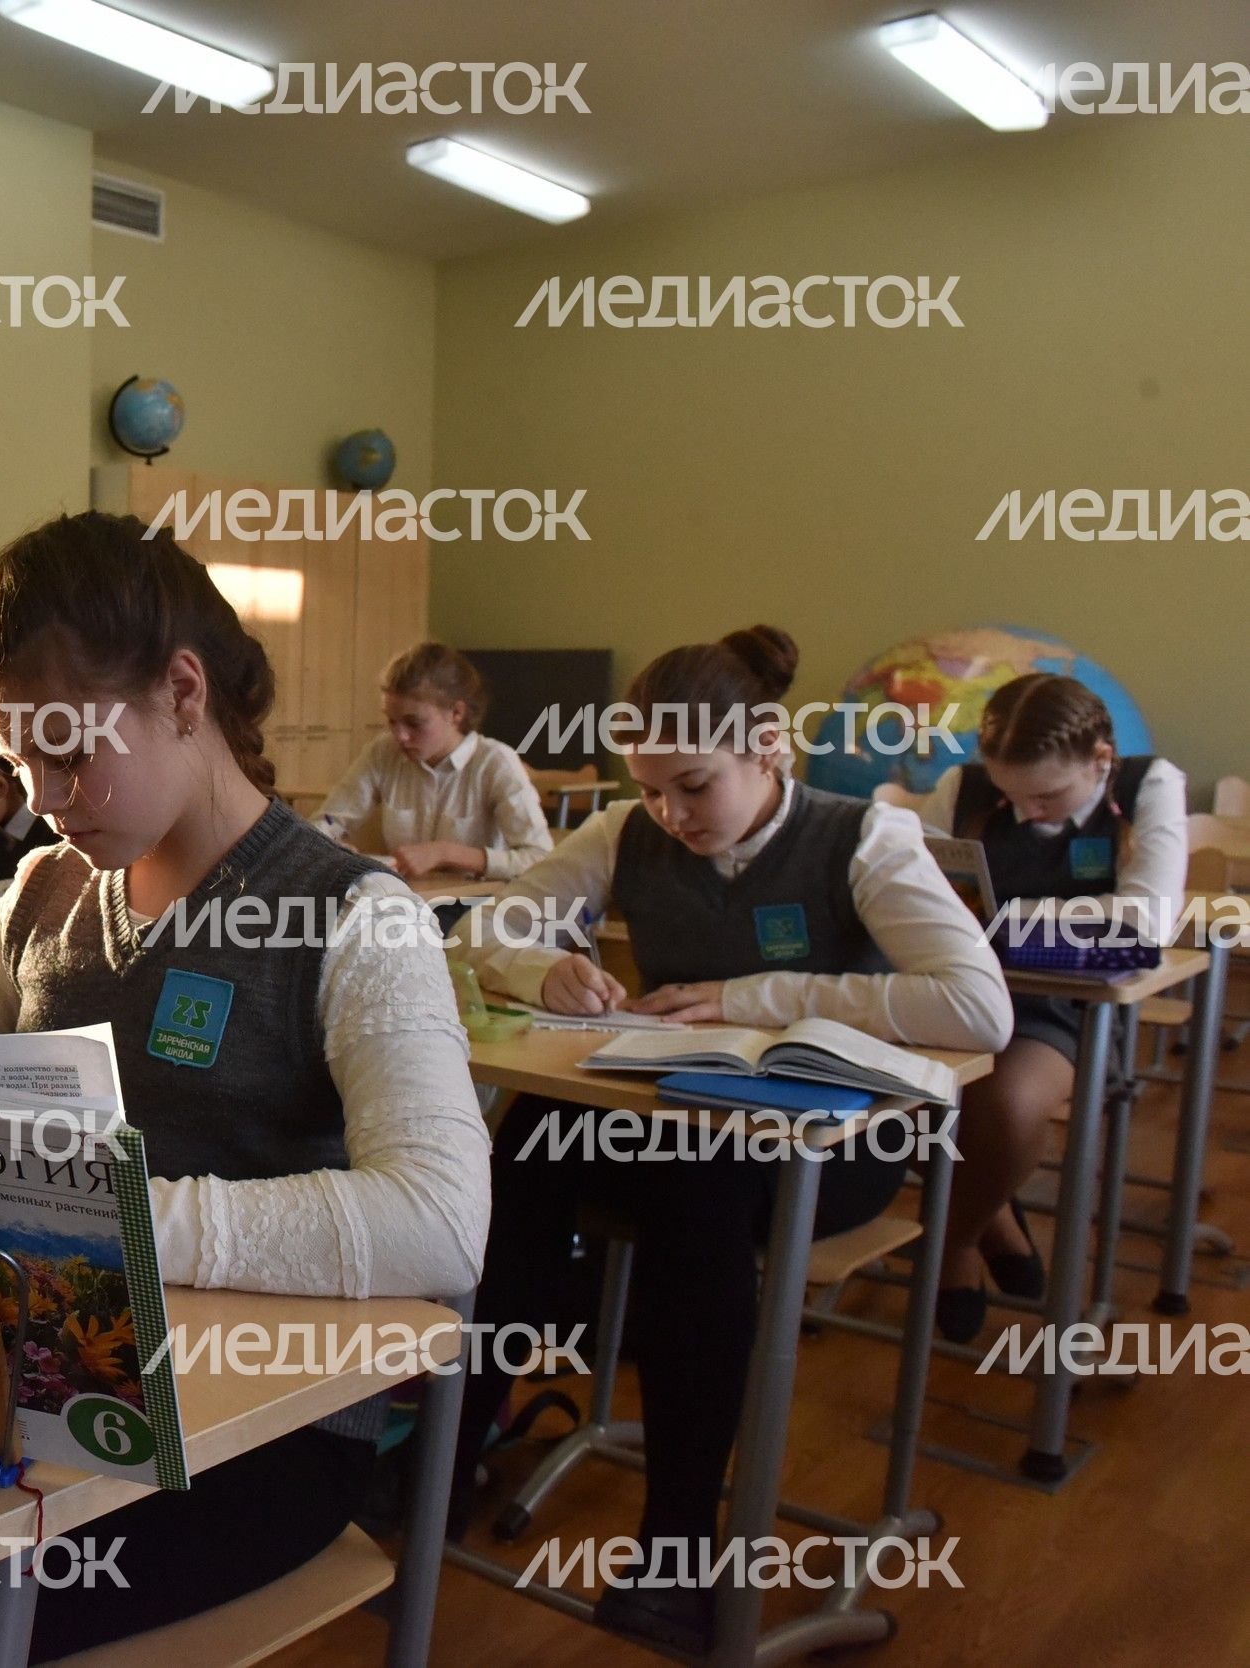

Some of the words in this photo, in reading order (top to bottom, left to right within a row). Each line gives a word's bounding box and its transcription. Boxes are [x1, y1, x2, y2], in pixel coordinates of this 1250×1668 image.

[156, 1032, 211, 1054] ЗАРЕЧЕНСКАЯ
[165, 1046, 195, 1061] ШКОЛА
[3, 1065, 51, 1073] количество
[34, 1074, 69, 1082] капуста
[31, 1082, 49, 1090] При
[55, 1201, 119, 1220] растений
[93, 1410, 132, 1456] 6
